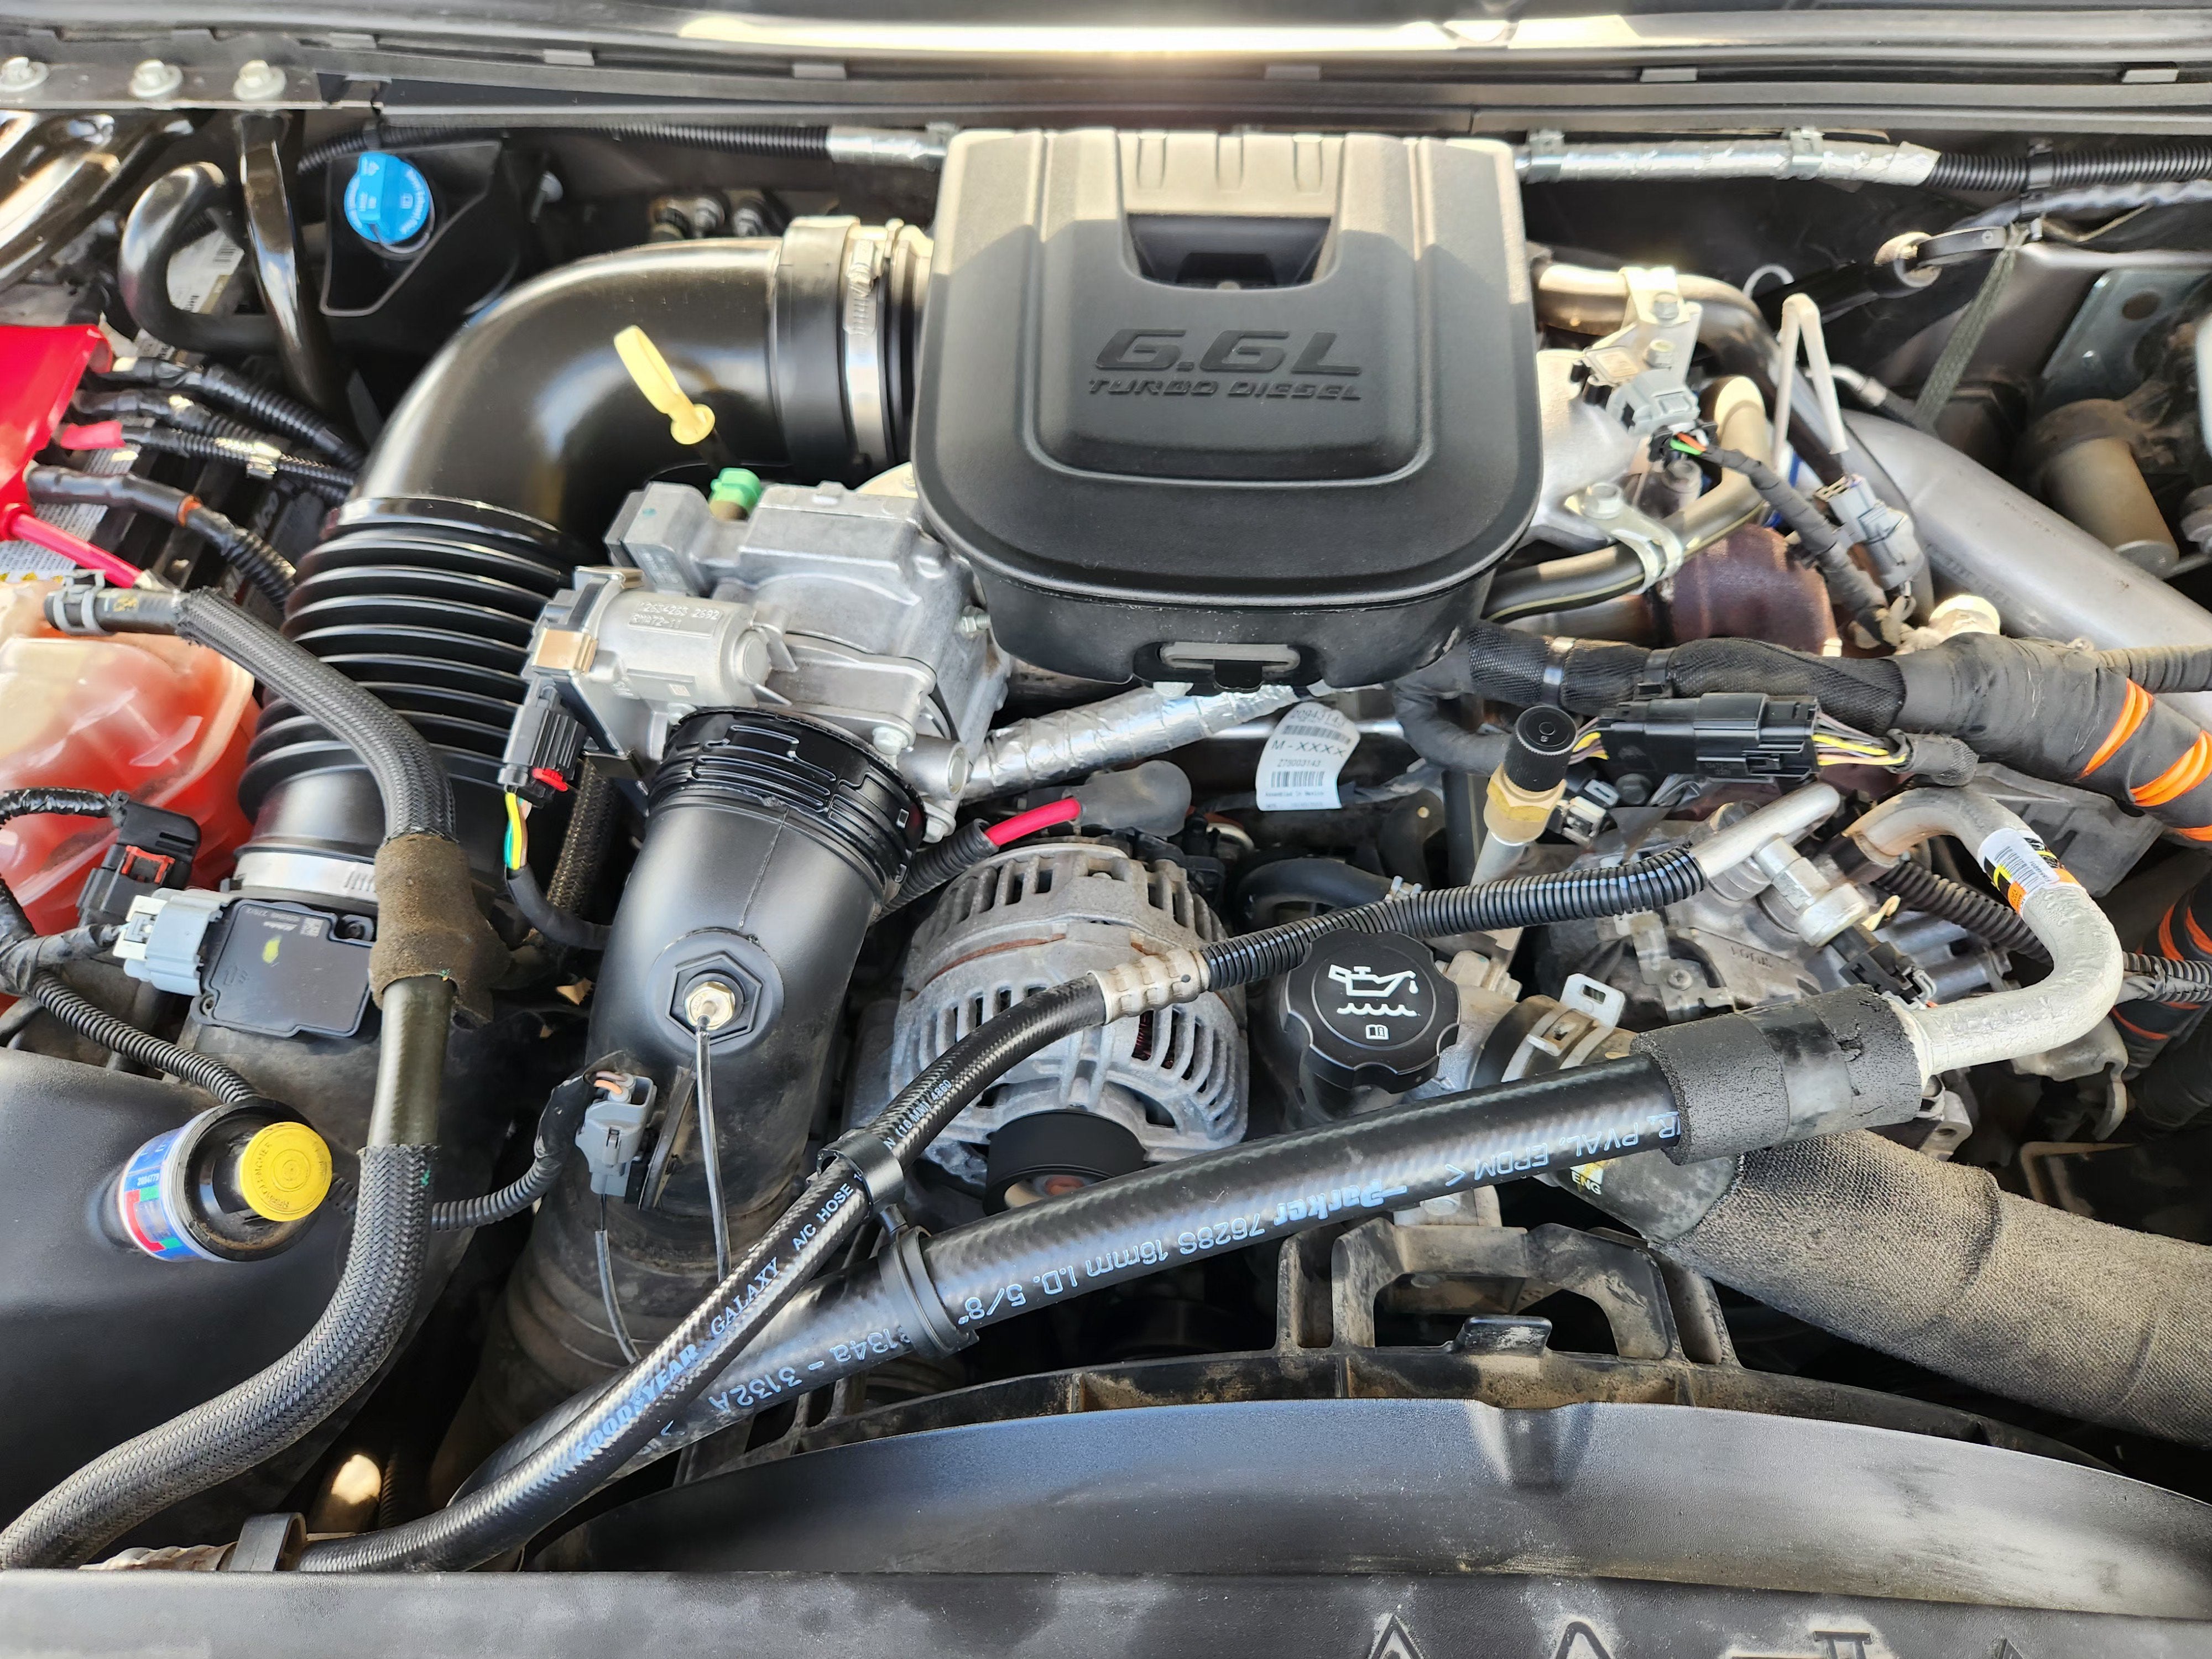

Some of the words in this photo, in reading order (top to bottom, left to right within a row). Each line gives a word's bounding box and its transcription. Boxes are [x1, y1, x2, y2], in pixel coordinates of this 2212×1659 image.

[1095, 329, 1362, 376] 6.6L
[1089, 379, 1219, 395] TURBO
[1228, 380, 1361, 400] DIESEL
[1474, 1142, 1548, 1181] EPDM
[1274, 1178, 1407, 1227] Parker
[1571, 1170, 1602, 1195] ENG
[710, 1256, 780, 1336] GALAXY
[792, 1223, 816, 1251] A/C
[816, 1183, 854, 1223] HOSE
[895, 1119, 912, 1138] (10
[909, 1101, 931, 1123] MM)
[931, 1079, 952, 1100] 4860
[1178, 1213, 1265, 1255] 7628S
[1086, 1239, 1168, 1277] 16mm
[1032, 1266, 1078, 1295] I.D.
[708, 1366, 802, 1413] 3132A
